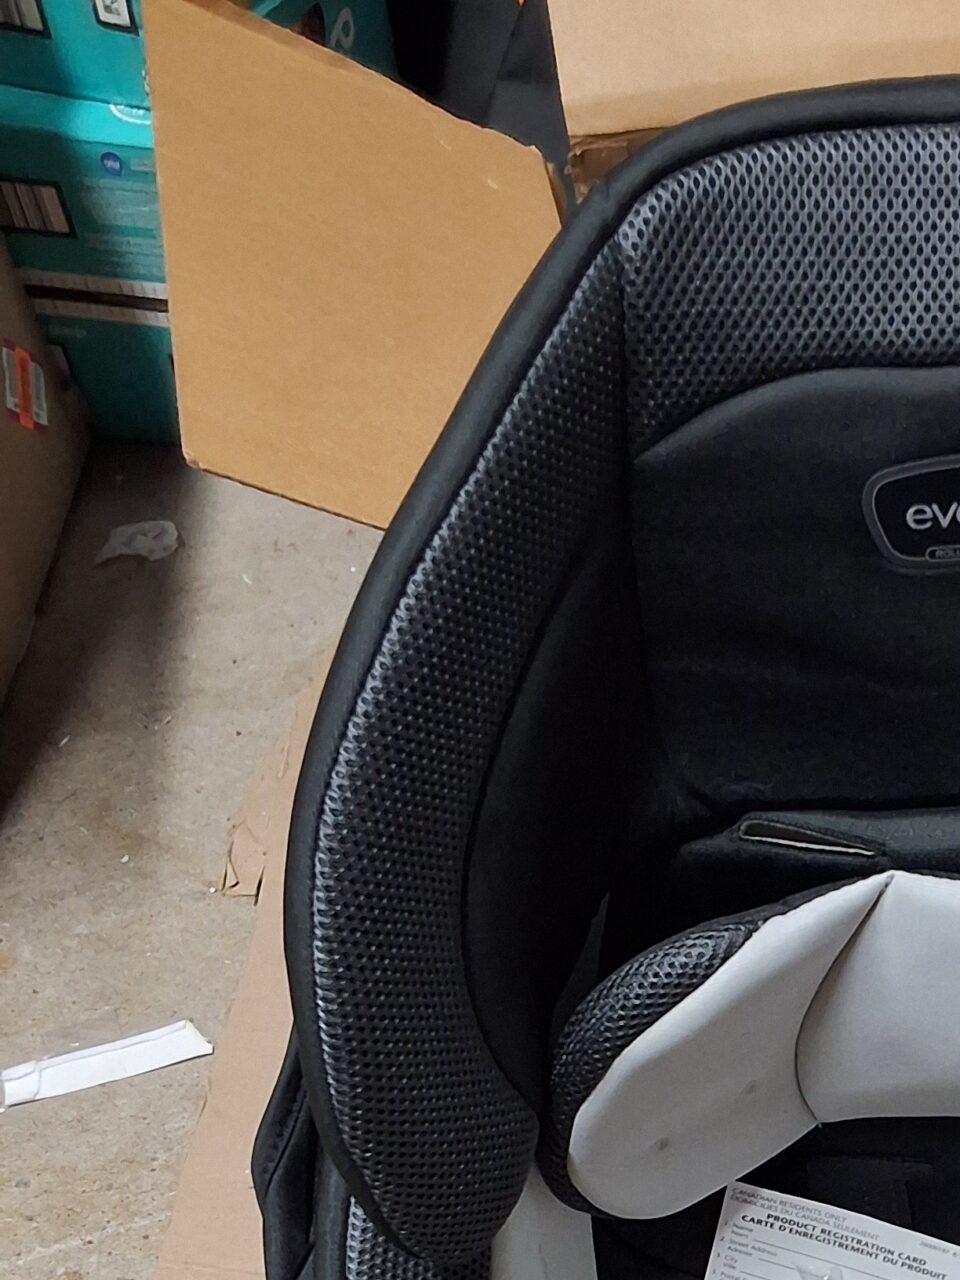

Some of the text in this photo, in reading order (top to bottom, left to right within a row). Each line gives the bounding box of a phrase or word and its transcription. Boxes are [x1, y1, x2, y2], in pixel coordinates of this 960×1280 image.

[740, 1213, 947, 1280] CARTE D'ENREGISTREMENT DU PRODUIT
[766, 1212, 816, 1233] PRODUCT
[819, 1227, 895, 1256] REGISTRATION
[897, 1251, 927, 1266] CARD
